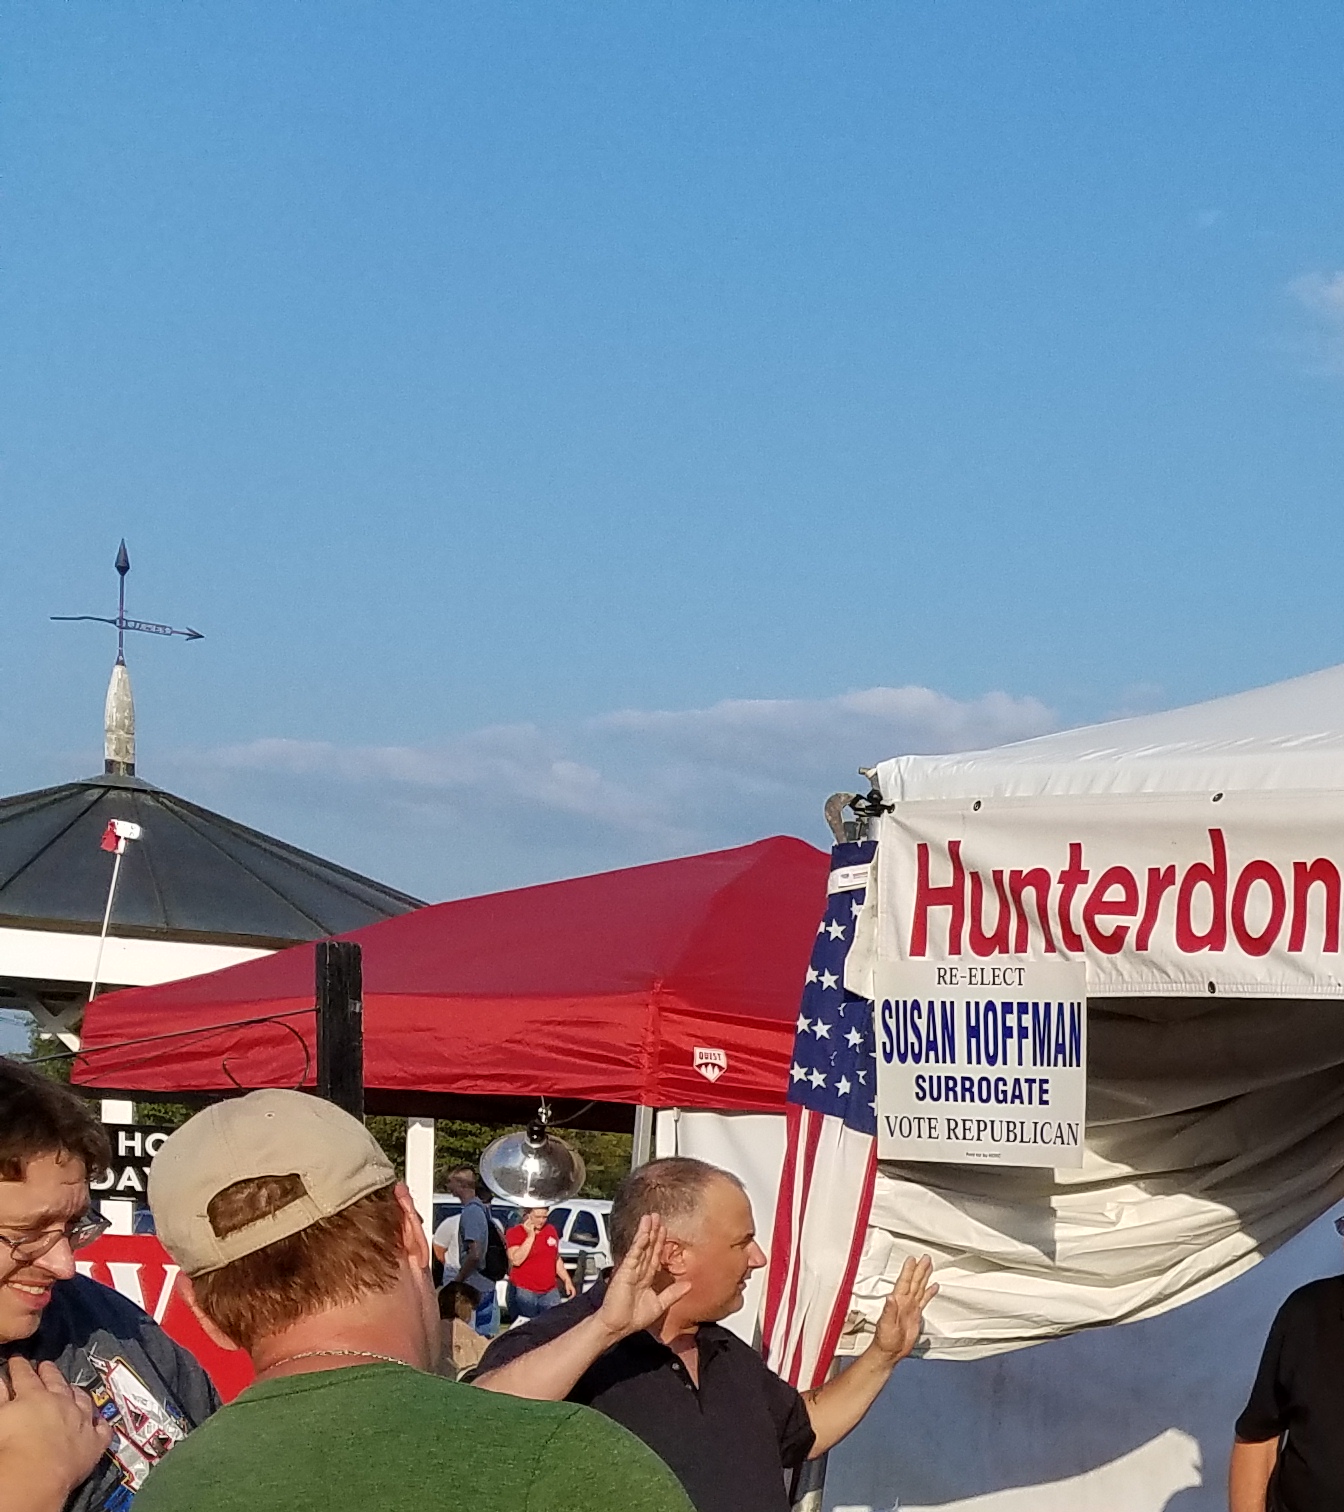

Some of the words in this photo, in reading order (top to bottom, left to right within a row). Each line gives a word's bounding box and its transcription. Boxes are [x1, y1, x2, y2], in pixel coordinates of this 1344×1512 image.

[909, 828, 1341, 957] Hunterdon
[937, 967, 1025, 986] RE-ELECT
[881, 999, 956, 1064] SUSAN
[966, 1000, 1081, 1067] HOFFMAN
[915, 1075, 1050, 1105] SURROGATE
[118, 1131, 169, 1157] HO
[884, 1116, 939, 1140] VOTE
[945, 1118, 1079, 1146] REPUBLICAN
